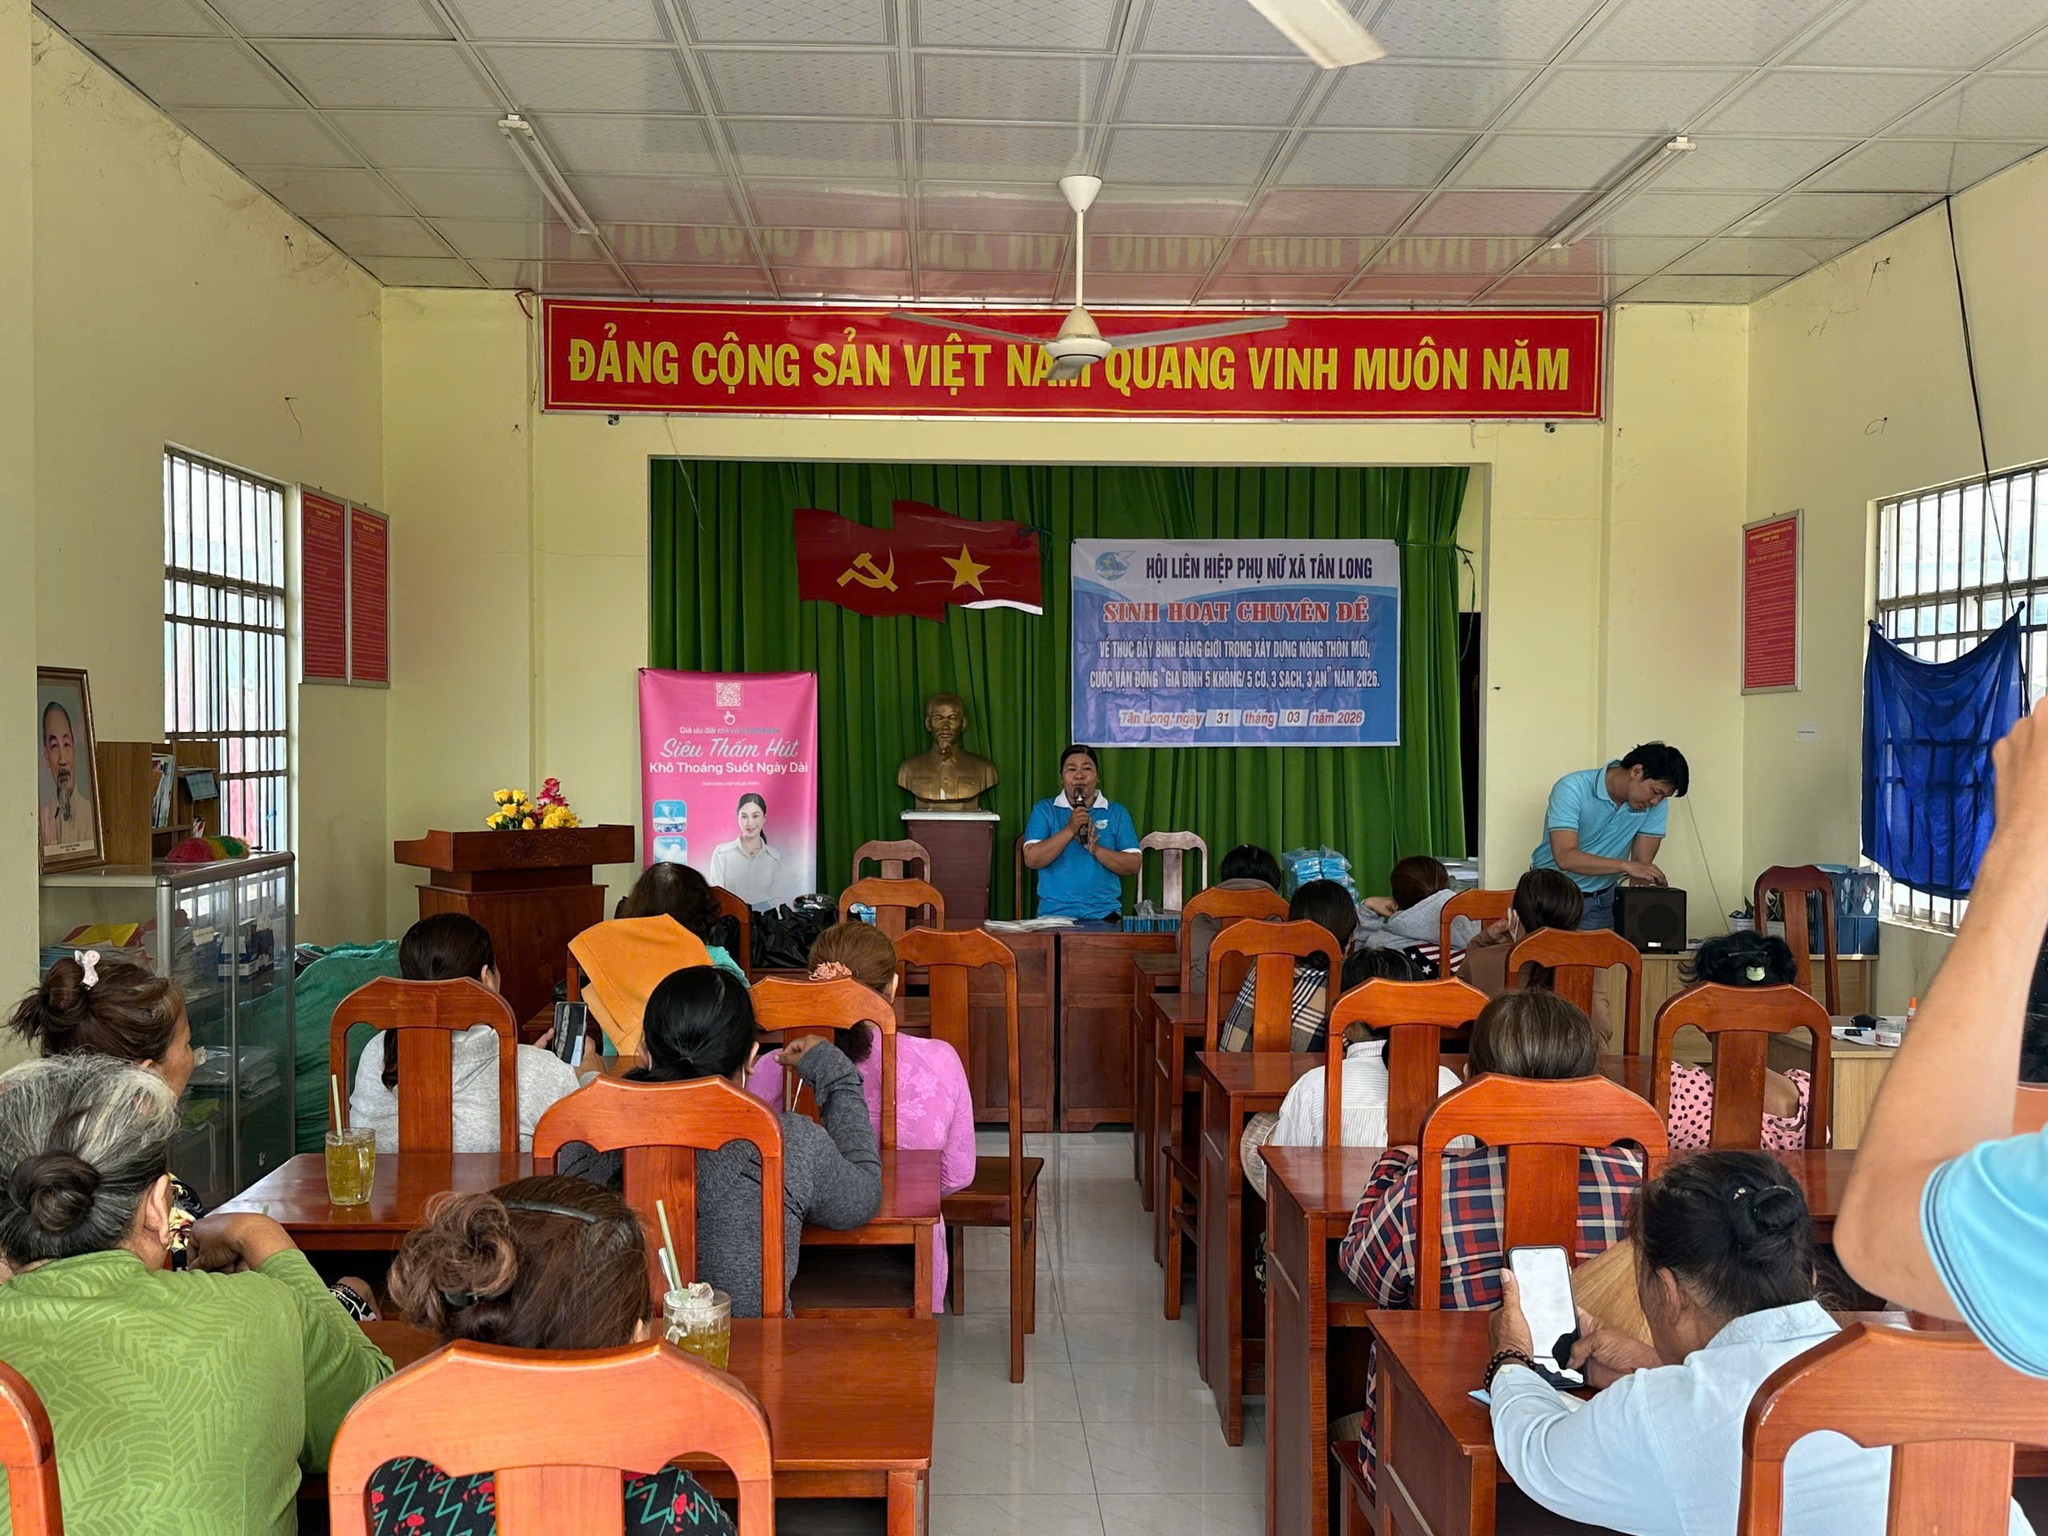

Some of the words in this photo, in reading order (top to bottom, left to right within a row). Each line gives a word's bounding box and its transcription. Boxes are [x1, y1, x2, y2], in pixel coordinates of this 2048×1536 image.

[568, 322, 678, 385] ĐẢNG
[691, 330, 800, 395] CỘNG
[812, 326, 890, 388] SẢN
[903, 332, 992, 396] VIỆT
[1104, 346, 1235, 397] QUANG
[1247, 346, 1338, 391] VINH
[1353, 336, 1468, 391] MUÔN
[1482, 338, 1570, 391] NĂM
[1146, 553, 1168, 584] HỘI
[1171, 553, 1200, 579] LIÊN
[1203, 553, 1233, 584] HIỆP
[1237, 557, 1263, 584] PHỤ
[1266, 553, 1286, 579] NỮ
[1288, 553, 1307, 579] XÃ
[1309, 553, 1335, 579] TÂN
[1338, 557, 1373, 579] LONG
[1103, 601, 1160, 623] SINH
[1167, 601, 1230, 625] HOẠT
[1236, 597, 1329, 623] CHUYÊN
[1336, 595, 1369, 623] ĐỀ
[1112, 637, 1135, 658] THÚC
[1224, 640, 1252, 658] TRONG
[1254, 637, 1272, 658] XÂY
[1299, 637, 1323, 658] NÔNG
[1326, 637, 1349, 658] THÔN
[1089, 667, 1113, 692] CUỘC
[1115, 667, 1133, 692] VẬN
[1135, 667, 1159, 692] ĐỘNG
[1182, 667, 1203, 688] ĐÌNH
[1205, 670, 1211, 688] 5
[1246, 670, 1253, 688] 5
[1271, 670, 1277, 688] 3
[1306, 670, 1313, 688] 3
[1334, 667, 1355, 688] NĂM
[1356, 670, 1380, 688] 2026.
[1121, 711, 1141, 724] Tân
[1175, 711, 1202, 727] ngày
[1216, 712, 1230, 724] 31
[1245, 711, 1275, 727] tháng
[1287, 711, 1301, 724] 03
[1312, 711, 1335, 724] năm
[1337, 711, 1363, 724] 2026
[660, 737, 703, 758] Siêu
[709, 737, 761, 758] Thấm
[765, 737, 800, 758] Hút
[649, 761, 675, 774] Khô
[676, 761, 724, 776] Thoáng
[725, 759, 754, 774] Suốt
[756, 762, 788, 776] Ngày
[789, 762, 809, 774] Dài
